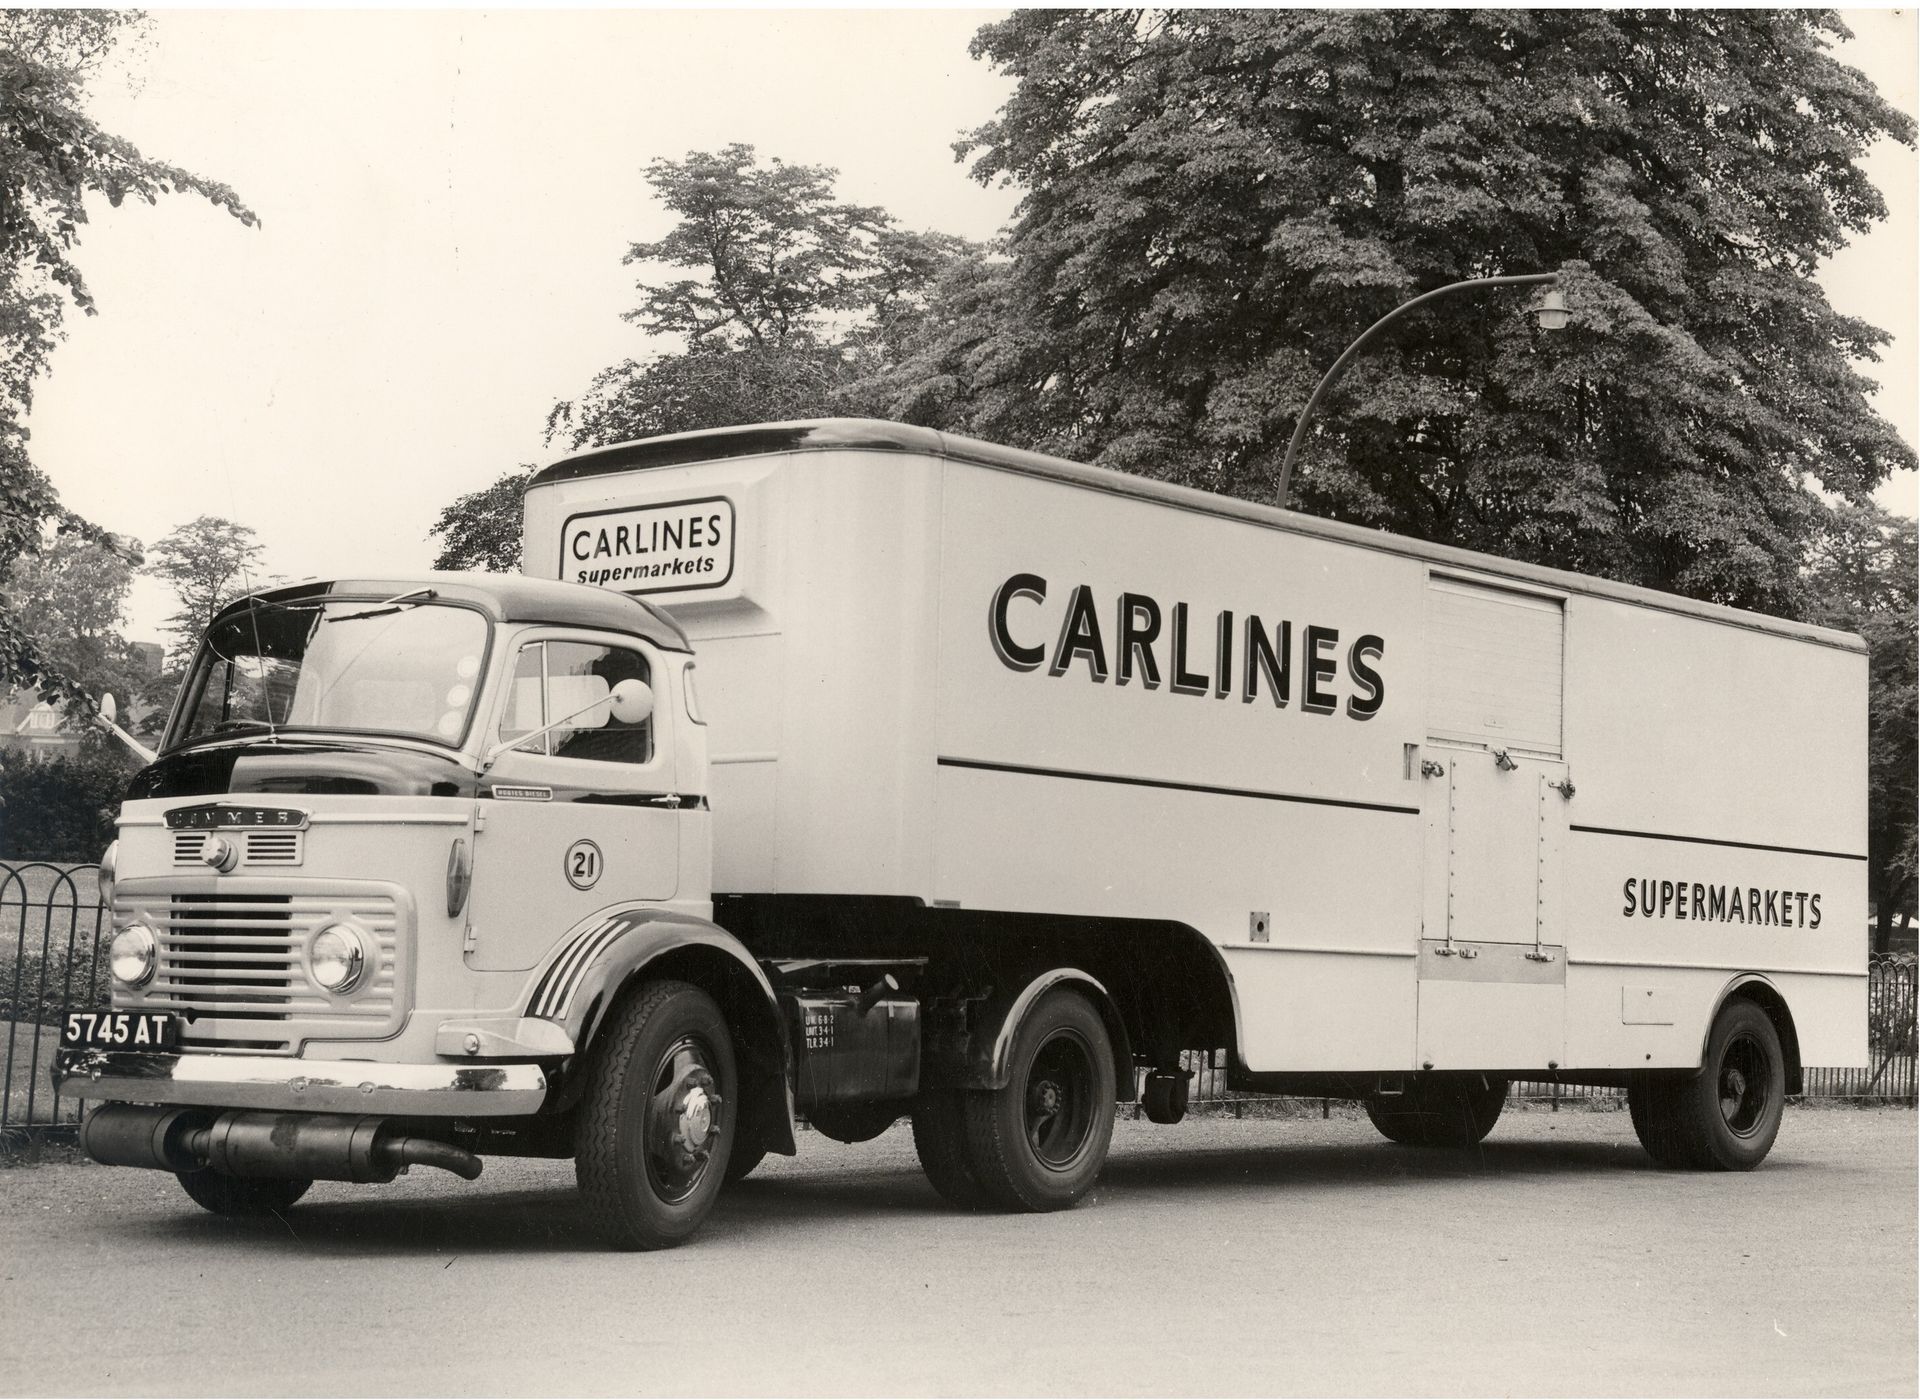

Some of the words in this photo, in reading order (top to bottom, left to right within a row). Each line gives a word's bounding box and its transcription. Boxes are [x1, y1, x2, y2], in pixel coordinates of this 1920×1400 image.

[572, 514, 721, 561] CARLINES
[577, 555, 715, 587] supermarkets
[988, 573, 1385, 721] CARLINES
[573, 851, 595, 878] 21
[1623, 877, 1822, 930] SUPERMARKETS
[66, 1013, 129, 1044] 5745
[134, 1015, 168, 1044] AT
